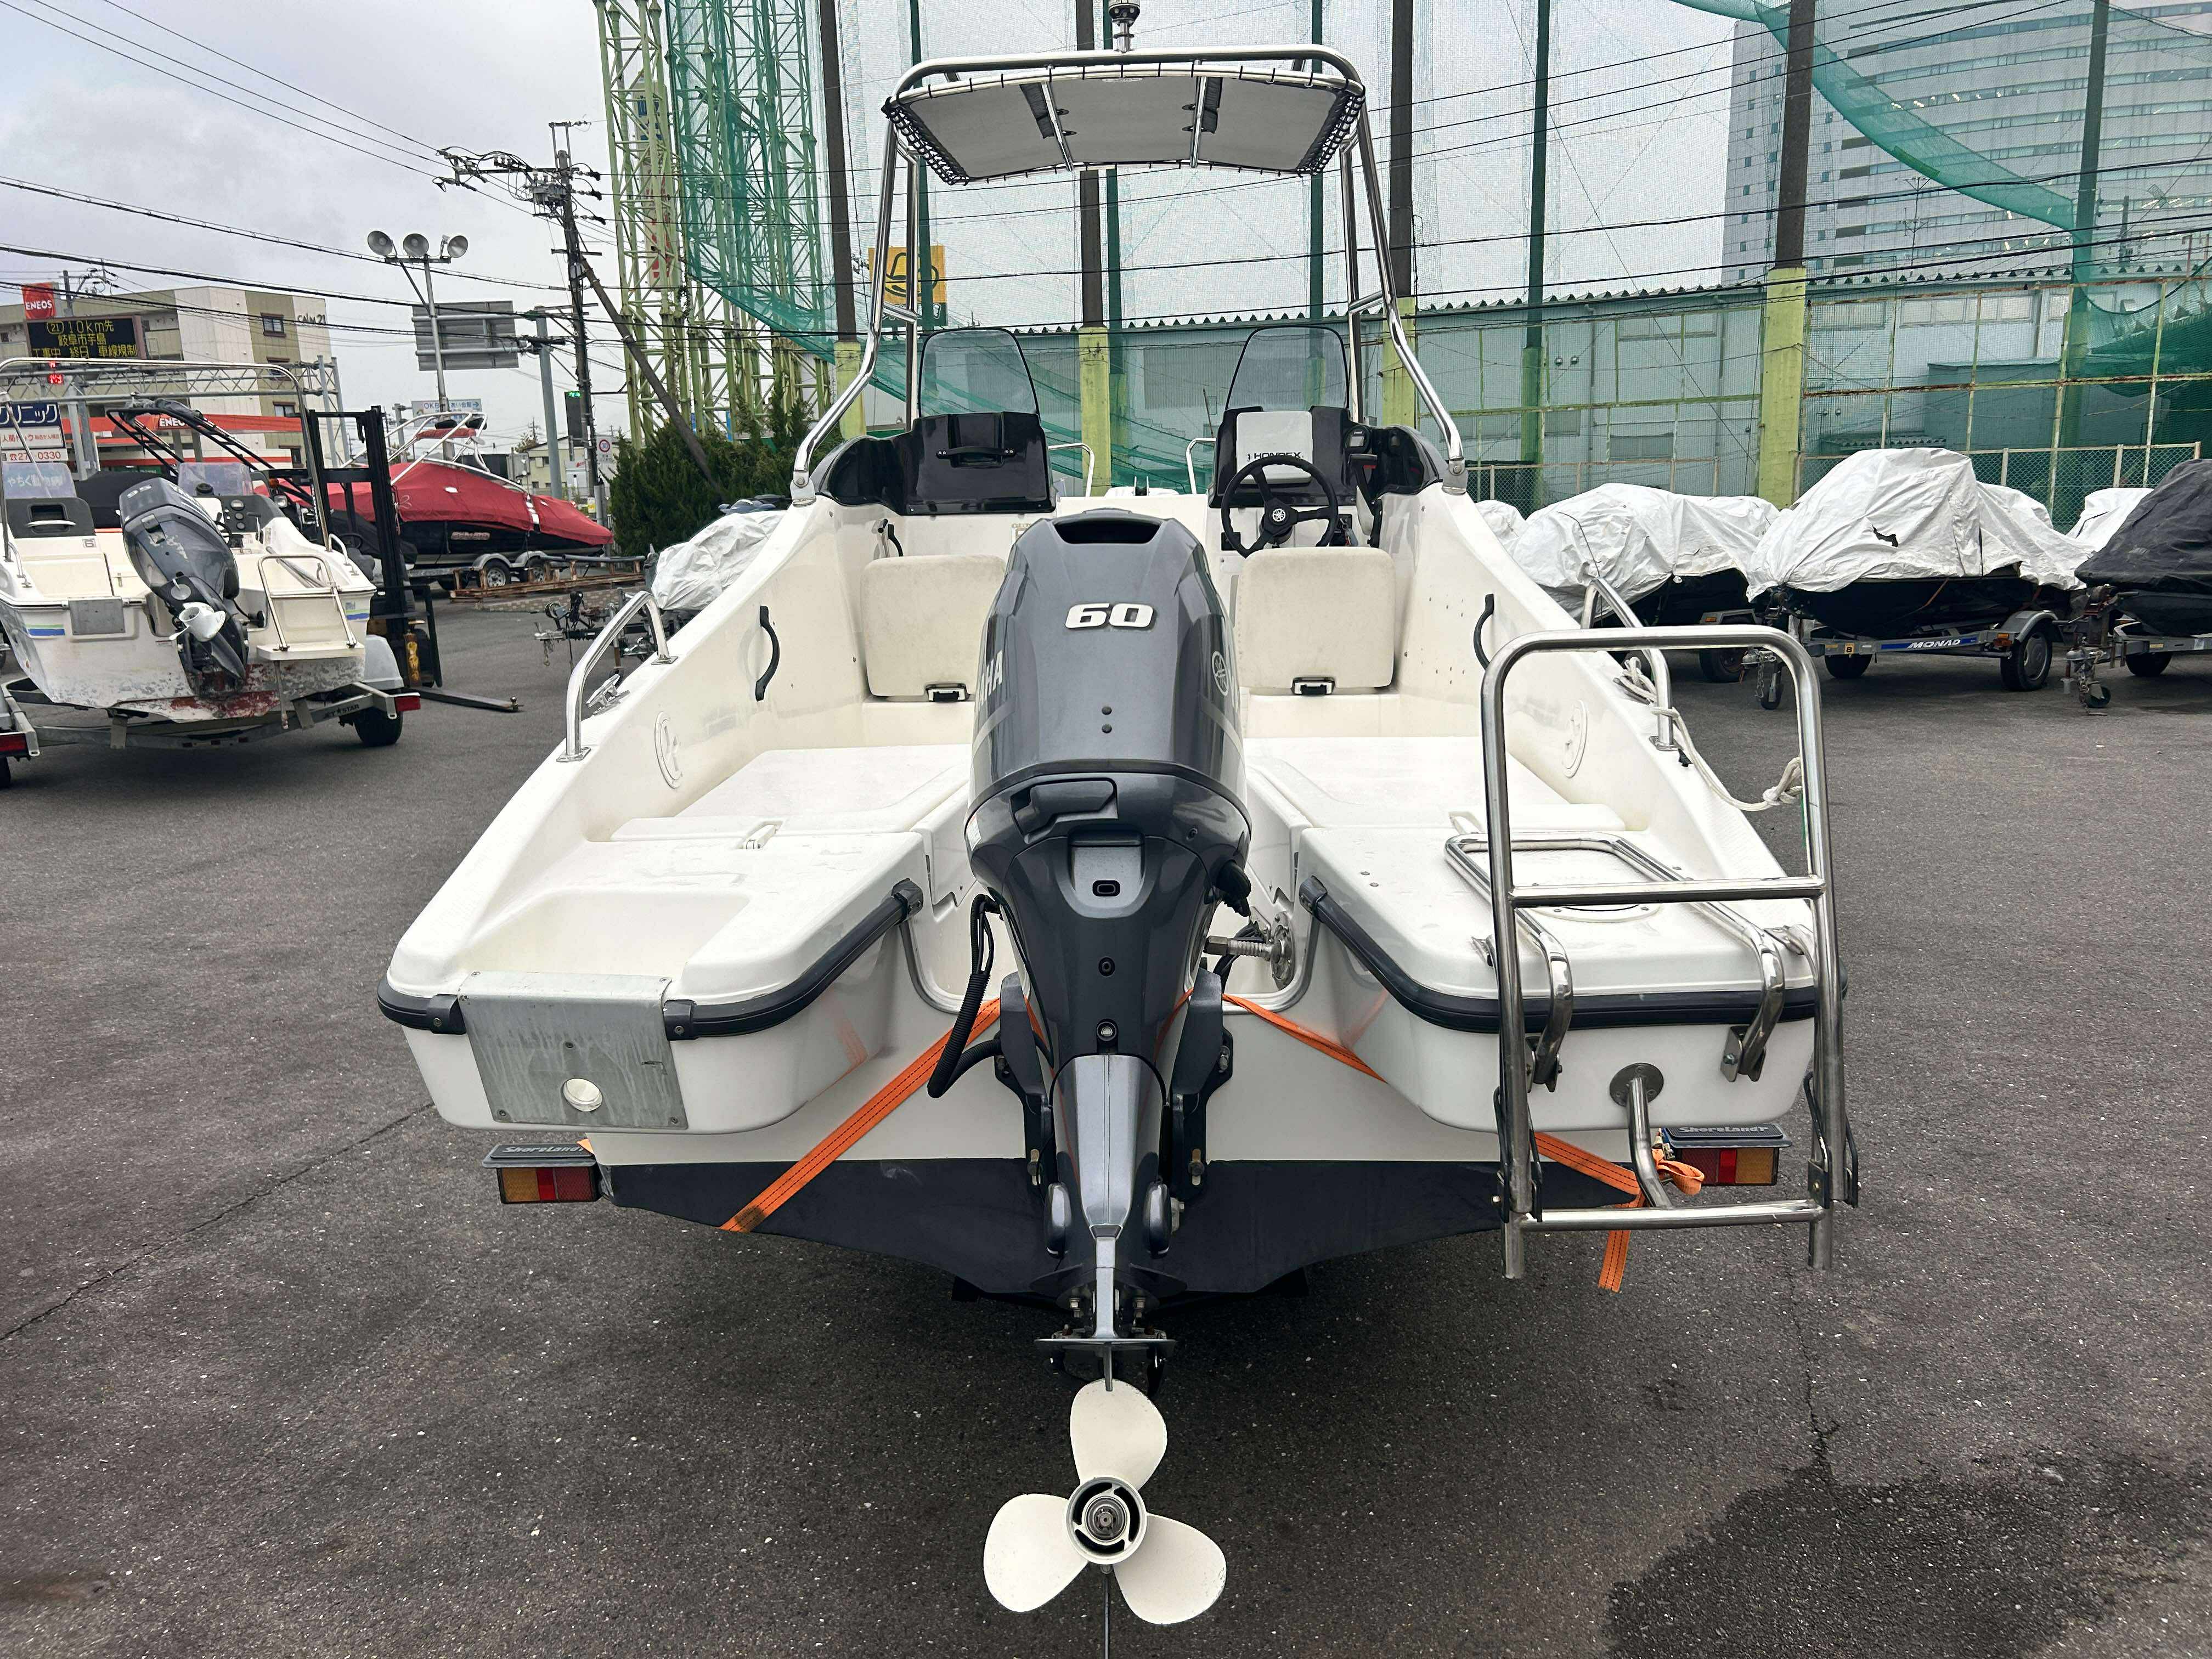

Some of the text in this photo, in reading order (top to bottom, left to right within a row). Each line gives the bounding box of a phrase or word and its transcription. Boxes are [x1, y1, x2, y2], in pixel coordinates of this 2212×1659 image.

[25, 300, 53, 311] ENEOS
[1065, 603, 1153, 629] 60
[1906, 639, 1961, 649] MONAD
